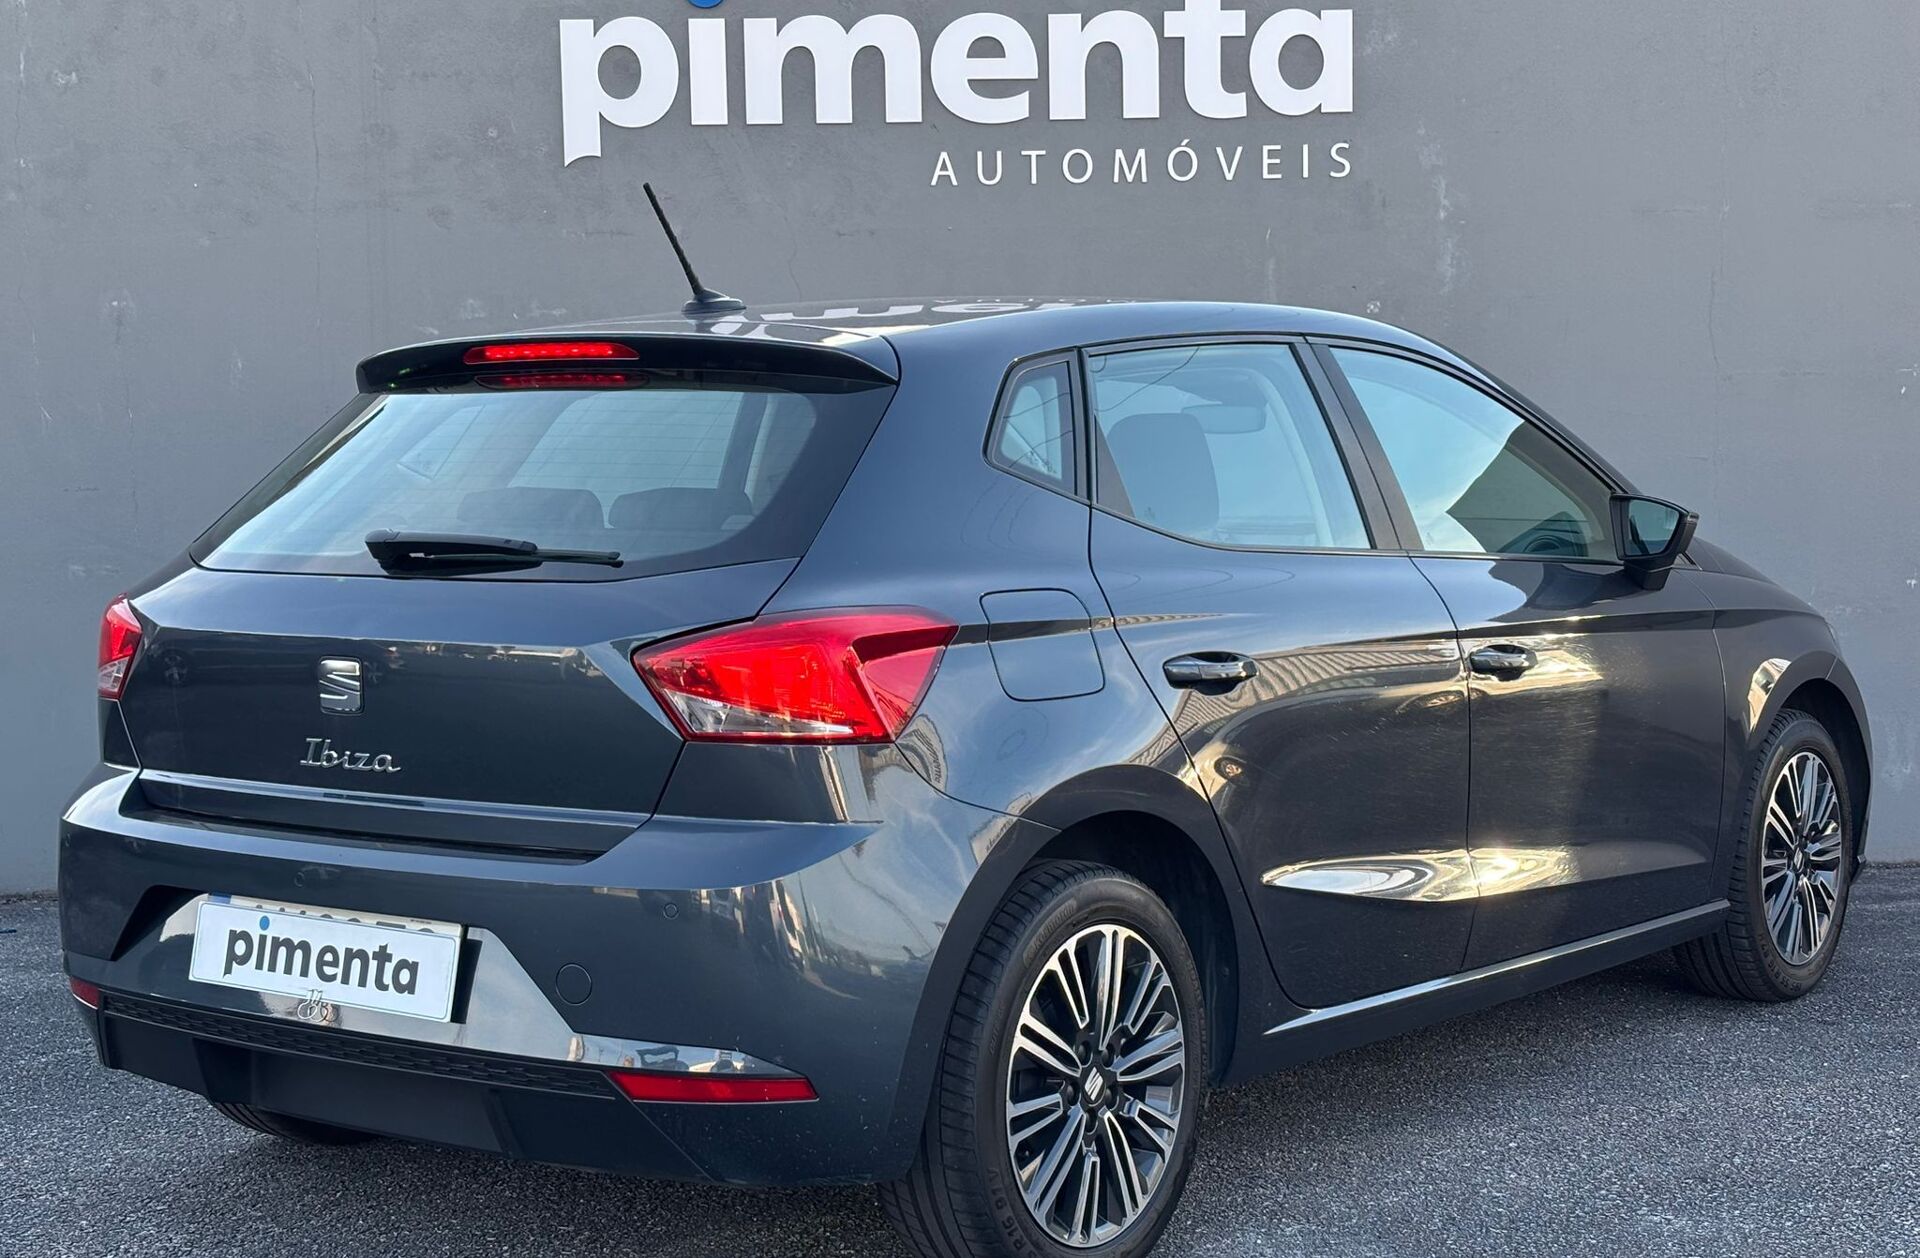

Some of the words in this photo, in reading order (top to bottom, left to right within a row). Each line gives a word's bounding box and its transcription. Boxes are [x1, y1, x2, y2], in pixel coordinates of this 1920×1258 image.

[558, 0, 1354, 167] pimenta
[930, 141, 1353, 187] AUTOMÓVEIS
[299, 737, 402, 773] Ibiza
[222, 915, 419, 995] pimenta
